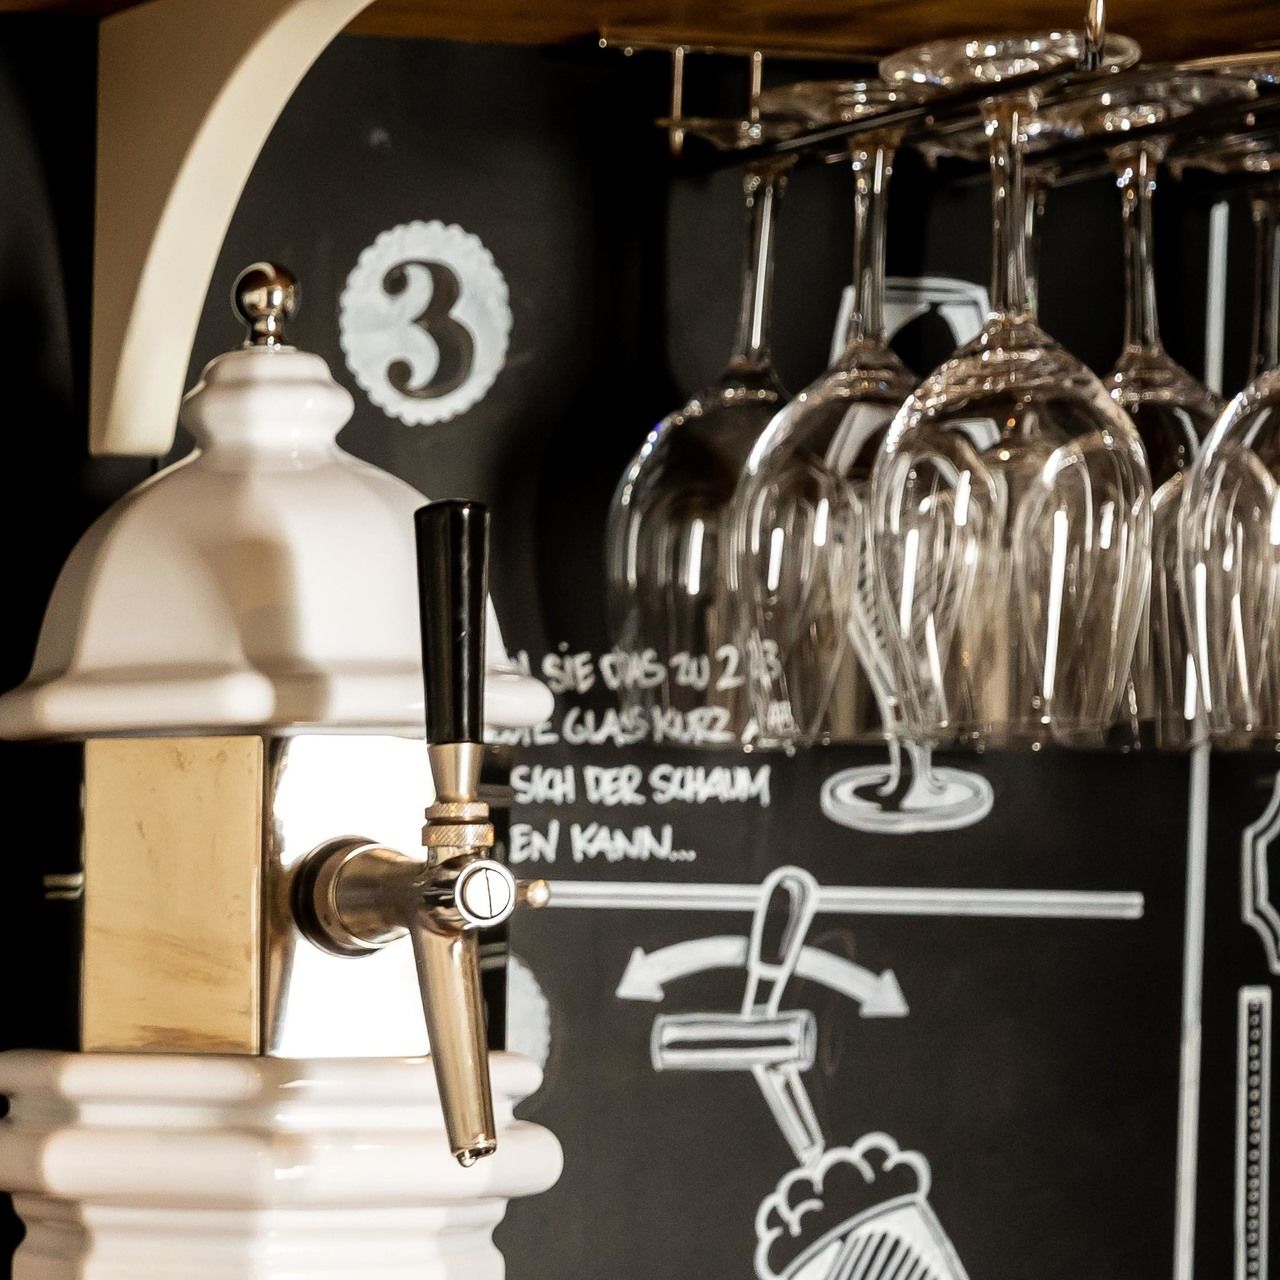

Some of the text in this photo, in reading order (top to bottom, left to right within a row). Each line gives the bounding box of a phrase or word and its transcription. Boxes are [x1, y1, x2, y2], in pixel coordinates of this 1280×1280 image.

[383, 260, 462, 396] 3
[542, 642, 595, 694] SIE
[600, 647, 668, 690] DAS
[670, 650, 711, 691] ZU
[562, 705, 649, 747] GLAS
[510, 763, 771, 807] SICH DER SCHAUM
[509, 819, 697, 864] EN KANN...
